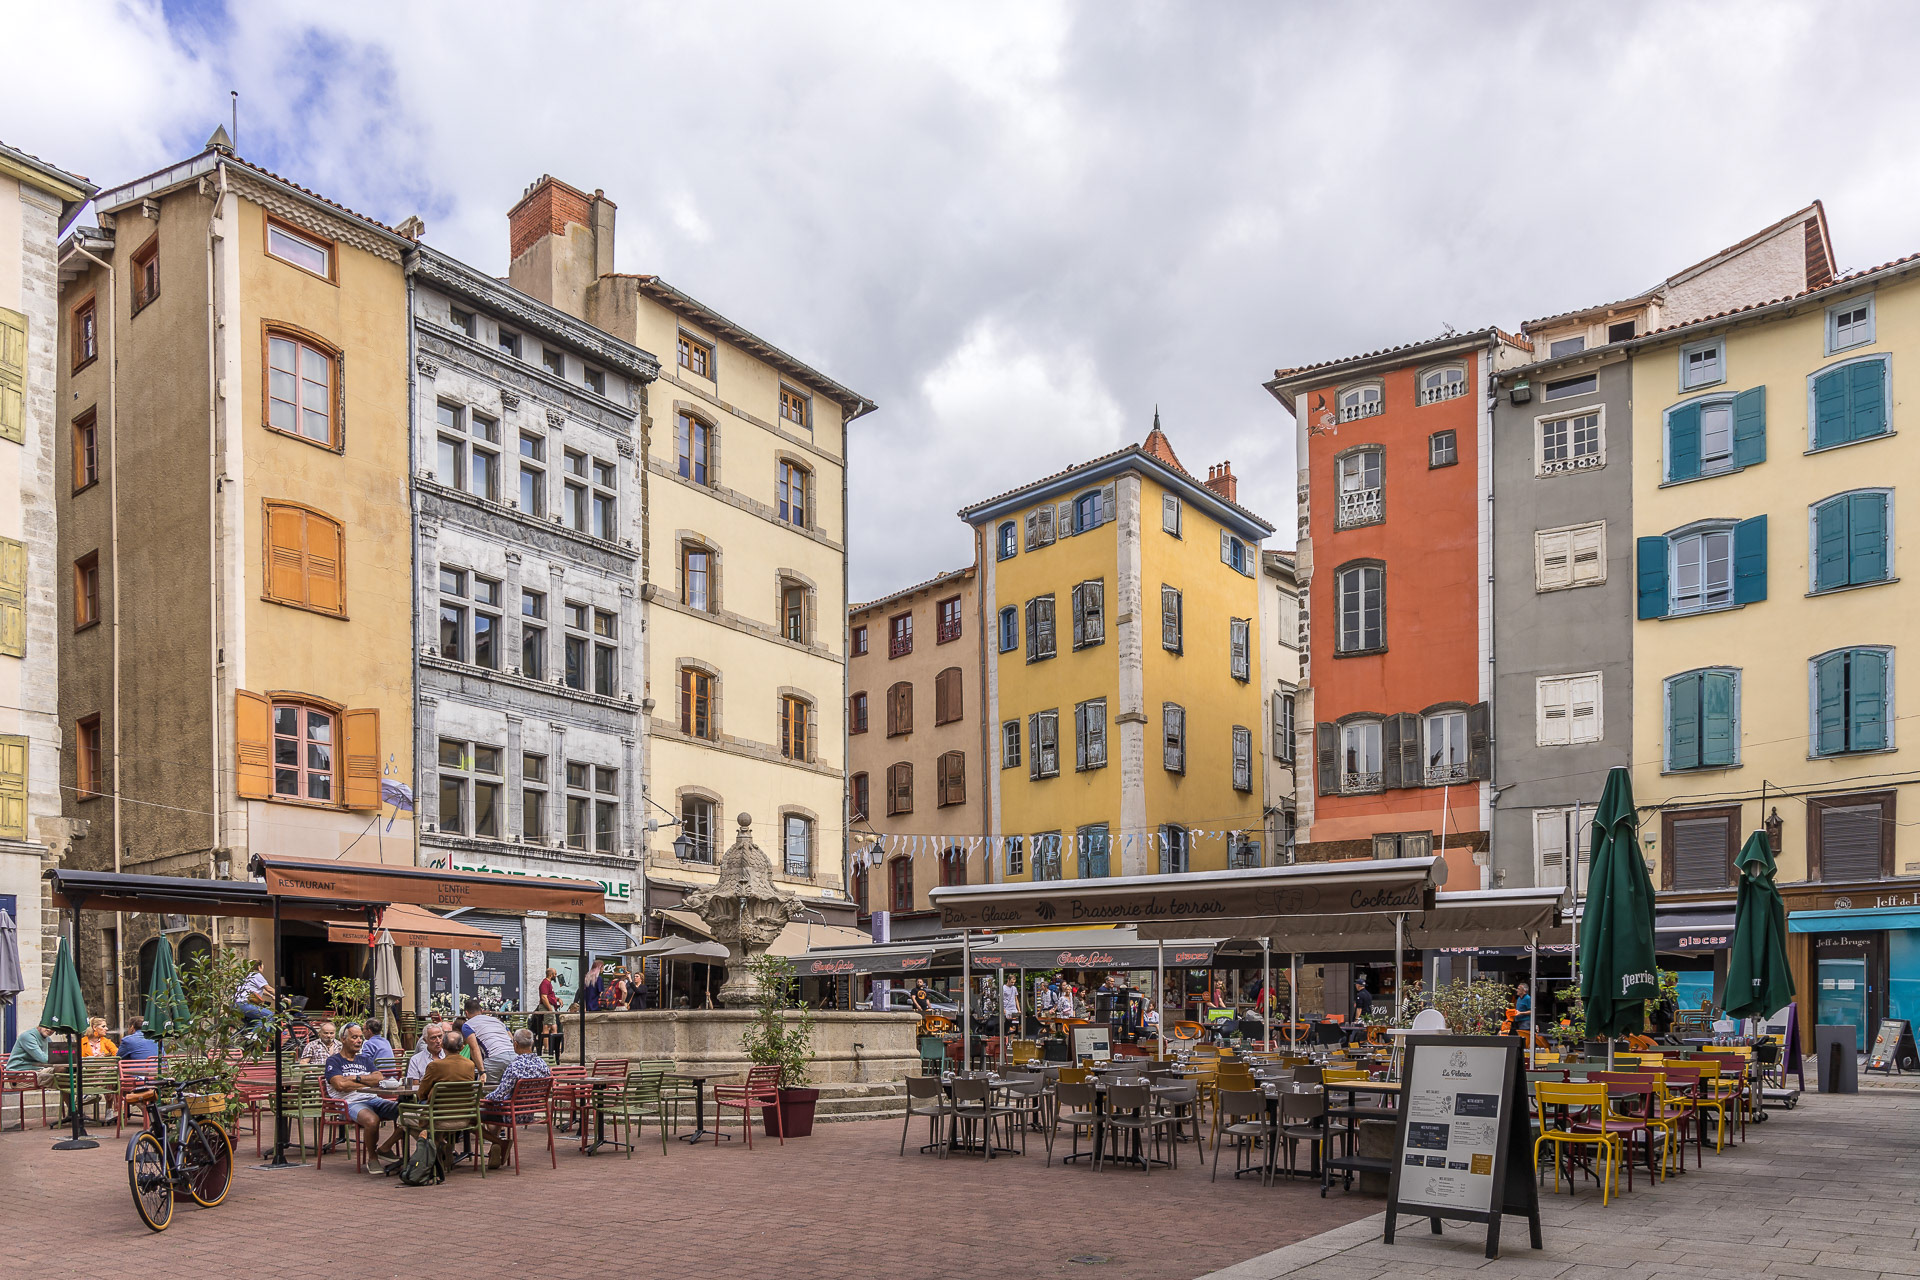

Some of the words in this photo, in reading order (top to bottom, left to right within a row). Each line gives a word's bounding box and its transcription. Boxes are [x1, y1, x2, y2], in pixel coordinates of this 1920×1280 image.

[279, 879, 336, 890] RESTAURANT
[438, 884, 470, 894] L'ENTRE
[438, 895, 462, 904] DEUX
[571, 898, 584, 906] BAR
[1350, 886, 1419, 908] Cocktails
[1873, 895, 1898, 908] Jeff
[1071, 899, 1141, 919] Brasserie
[1145, 896, 1167, 915] du
[1170, 898, 1225, 914] terroir
[944, 907, 968, 923] Bar
[981, 905, 1022, 922] Glacier
[1679, 935, 1727, 947] glaces
[1816, 938, 1832, 947] Jeff
[1840, 937, 1871, 947] Bruges
[901, 957, 927, 968] glaces
[1175, 952, 1209, 962] glaces
[1441, 1068, 1450, 1077] La
